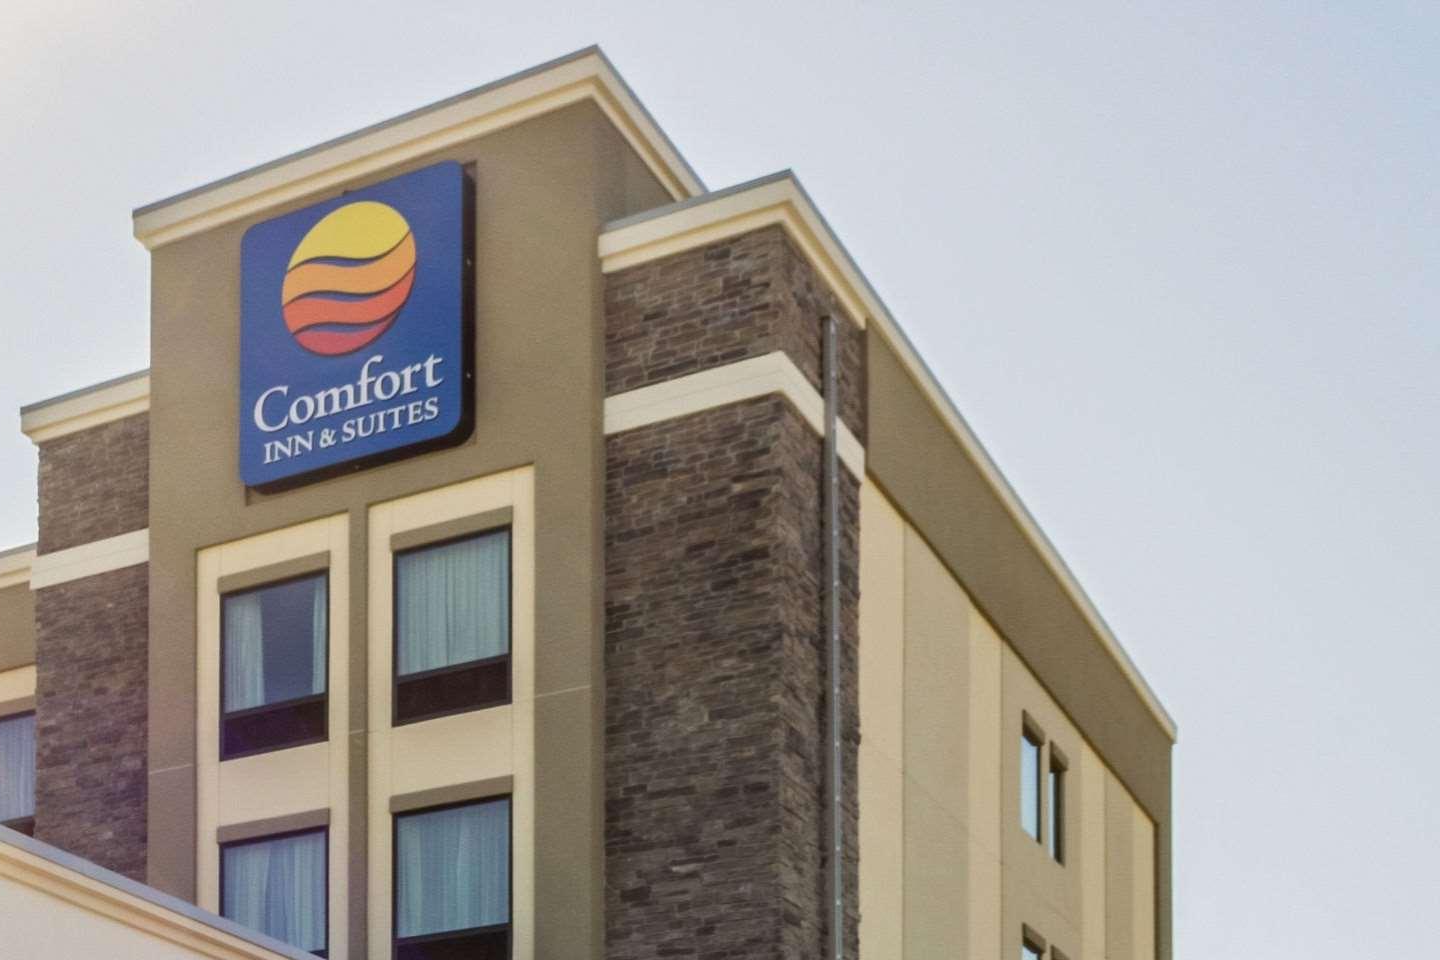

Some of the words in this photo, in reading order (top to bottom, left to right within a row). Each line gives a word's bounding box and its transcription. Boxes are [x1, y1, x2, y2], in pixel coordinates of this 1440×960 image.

[253, 353, 445, 433] Comfort
[263, 430, 314, 465] INN
[319, 427, 337, 449] &
[341, 396, 439, 443] SUITES
